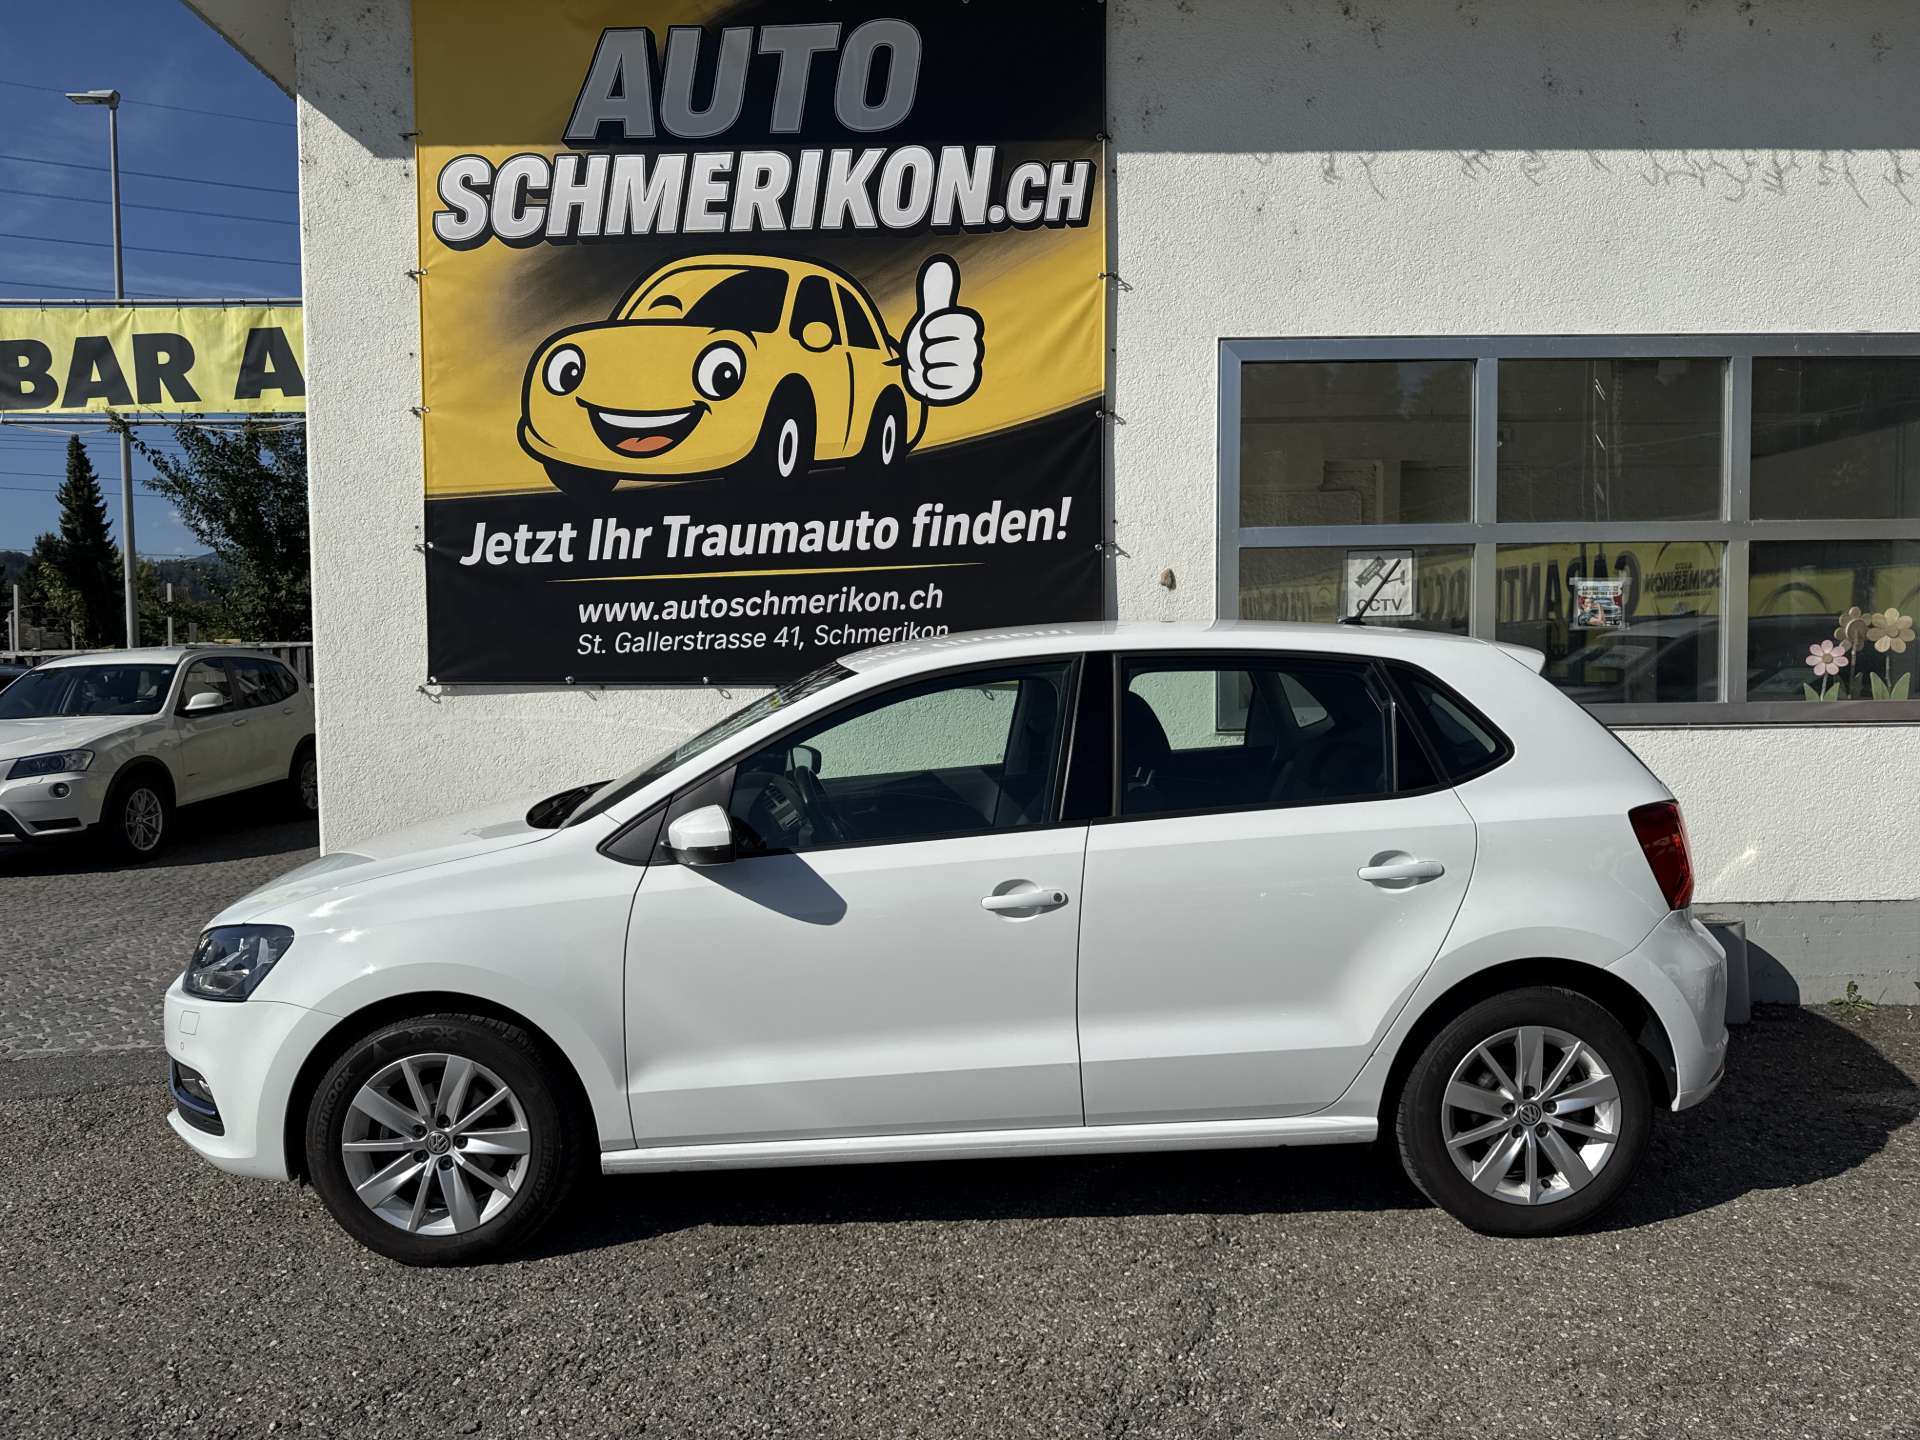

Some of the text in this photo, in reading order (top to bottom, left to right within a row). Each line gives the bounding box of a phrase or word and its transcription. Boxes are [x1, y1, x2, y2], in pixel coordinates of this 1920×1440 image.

[568, 20, 921, 138] AUTO
[434, 144, 1090, 243] SCHMERIKON.CH
[0, 332, 202, 411] BAR
[459, 496, 1073, 566] Jetzt Ihr Traumauto finden!
[577, 621, 950, 655] St. Gallerstrasse 41, Schmerikon
[578, 582, 943, 624] www.autoschmerikon.ch
[1356, 598, 1403, 612] CCTV
